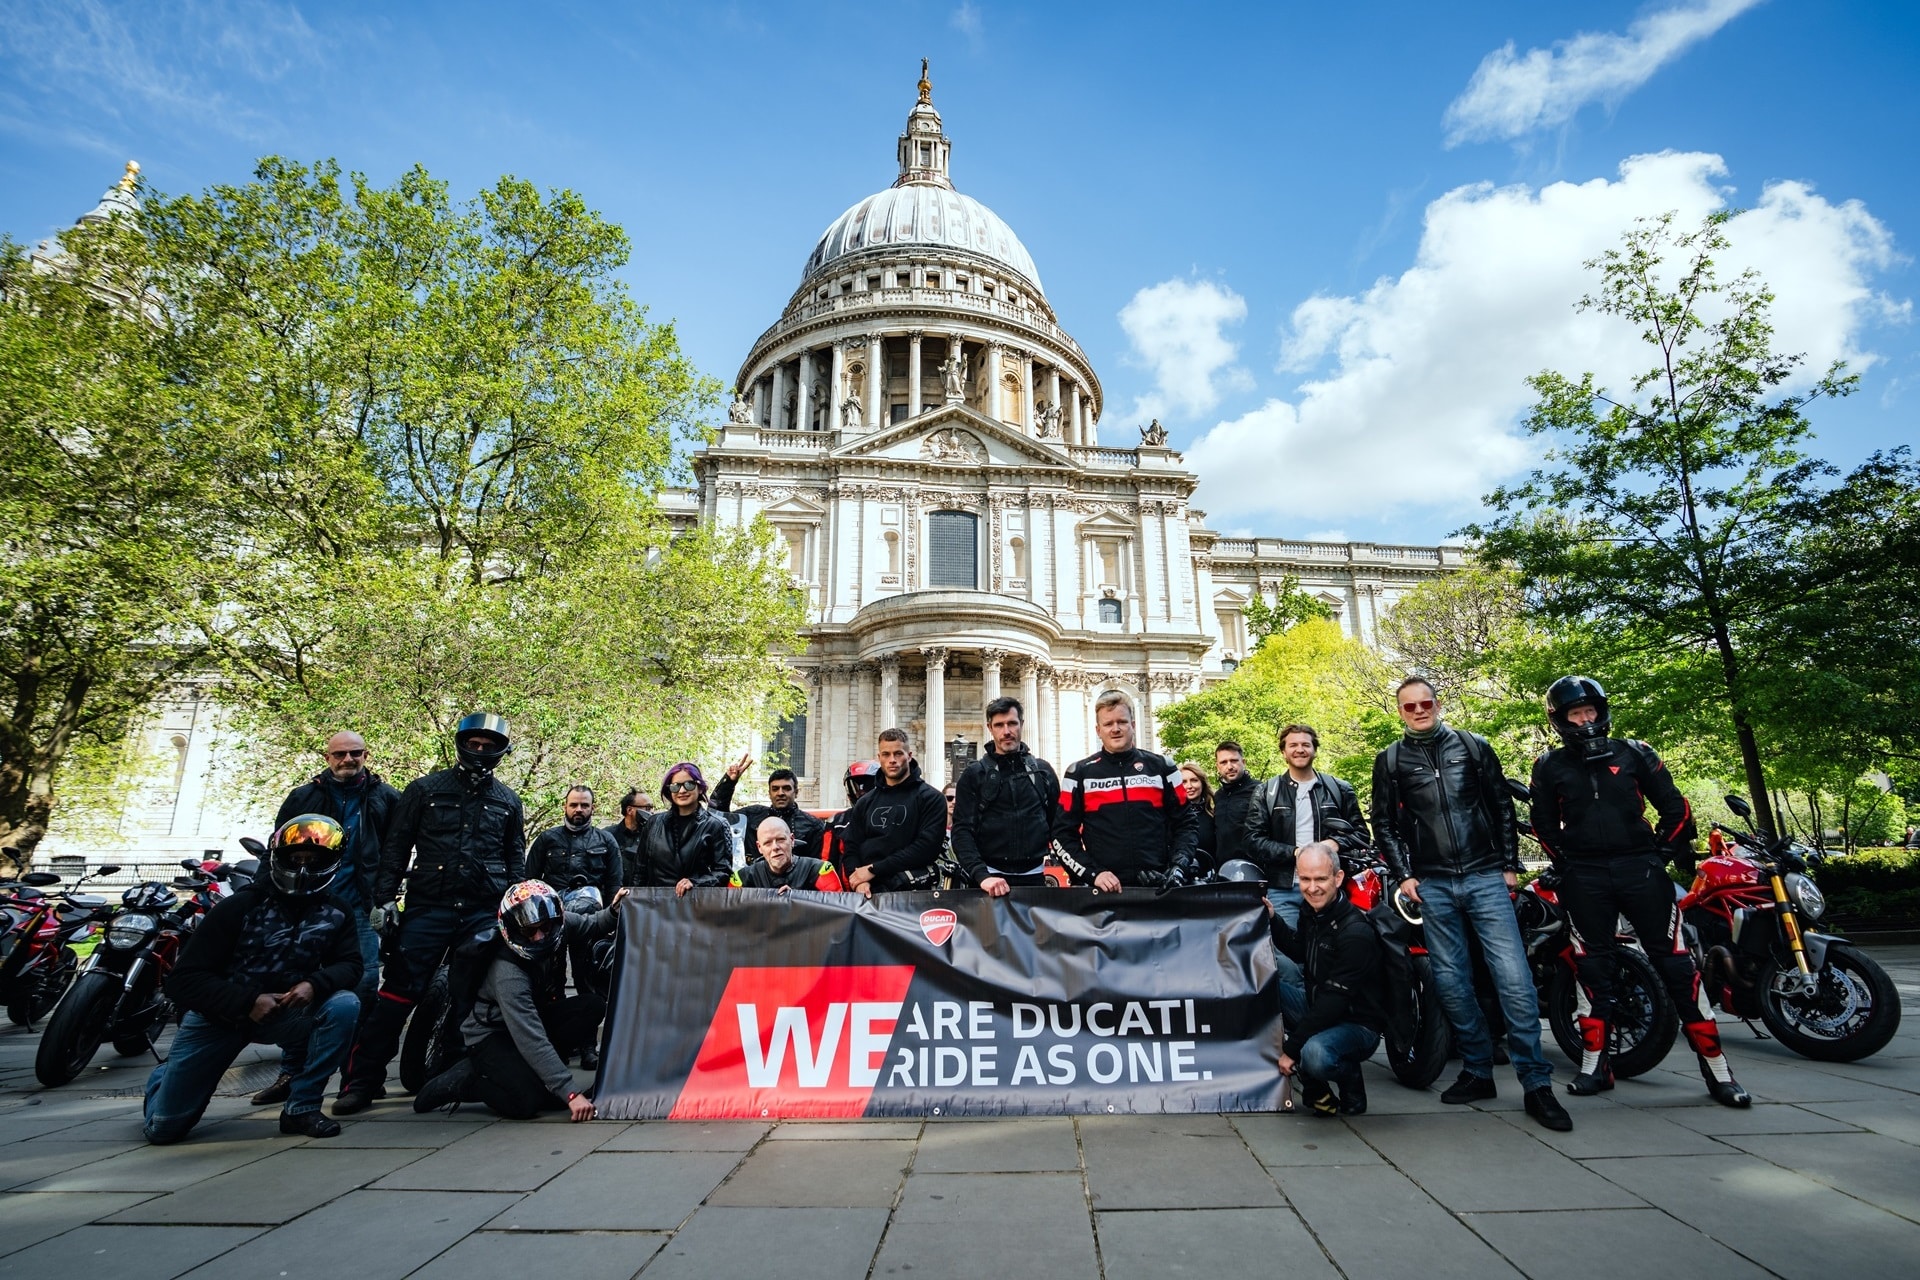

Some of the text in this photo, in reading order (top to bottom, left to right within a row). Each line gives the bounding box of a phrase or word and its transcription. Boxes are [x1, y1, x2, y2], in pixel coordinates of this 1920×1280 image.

[1052, 838, 1087, 878] DUCATI
[923, 914, 953, 922] DUCATI
[906, 998, 1211, 1040] ARE DUCATI.
[736, 1002, 904, 1088] WE
[887, 1040, 1213, 1087] RIDE AS ONE.
